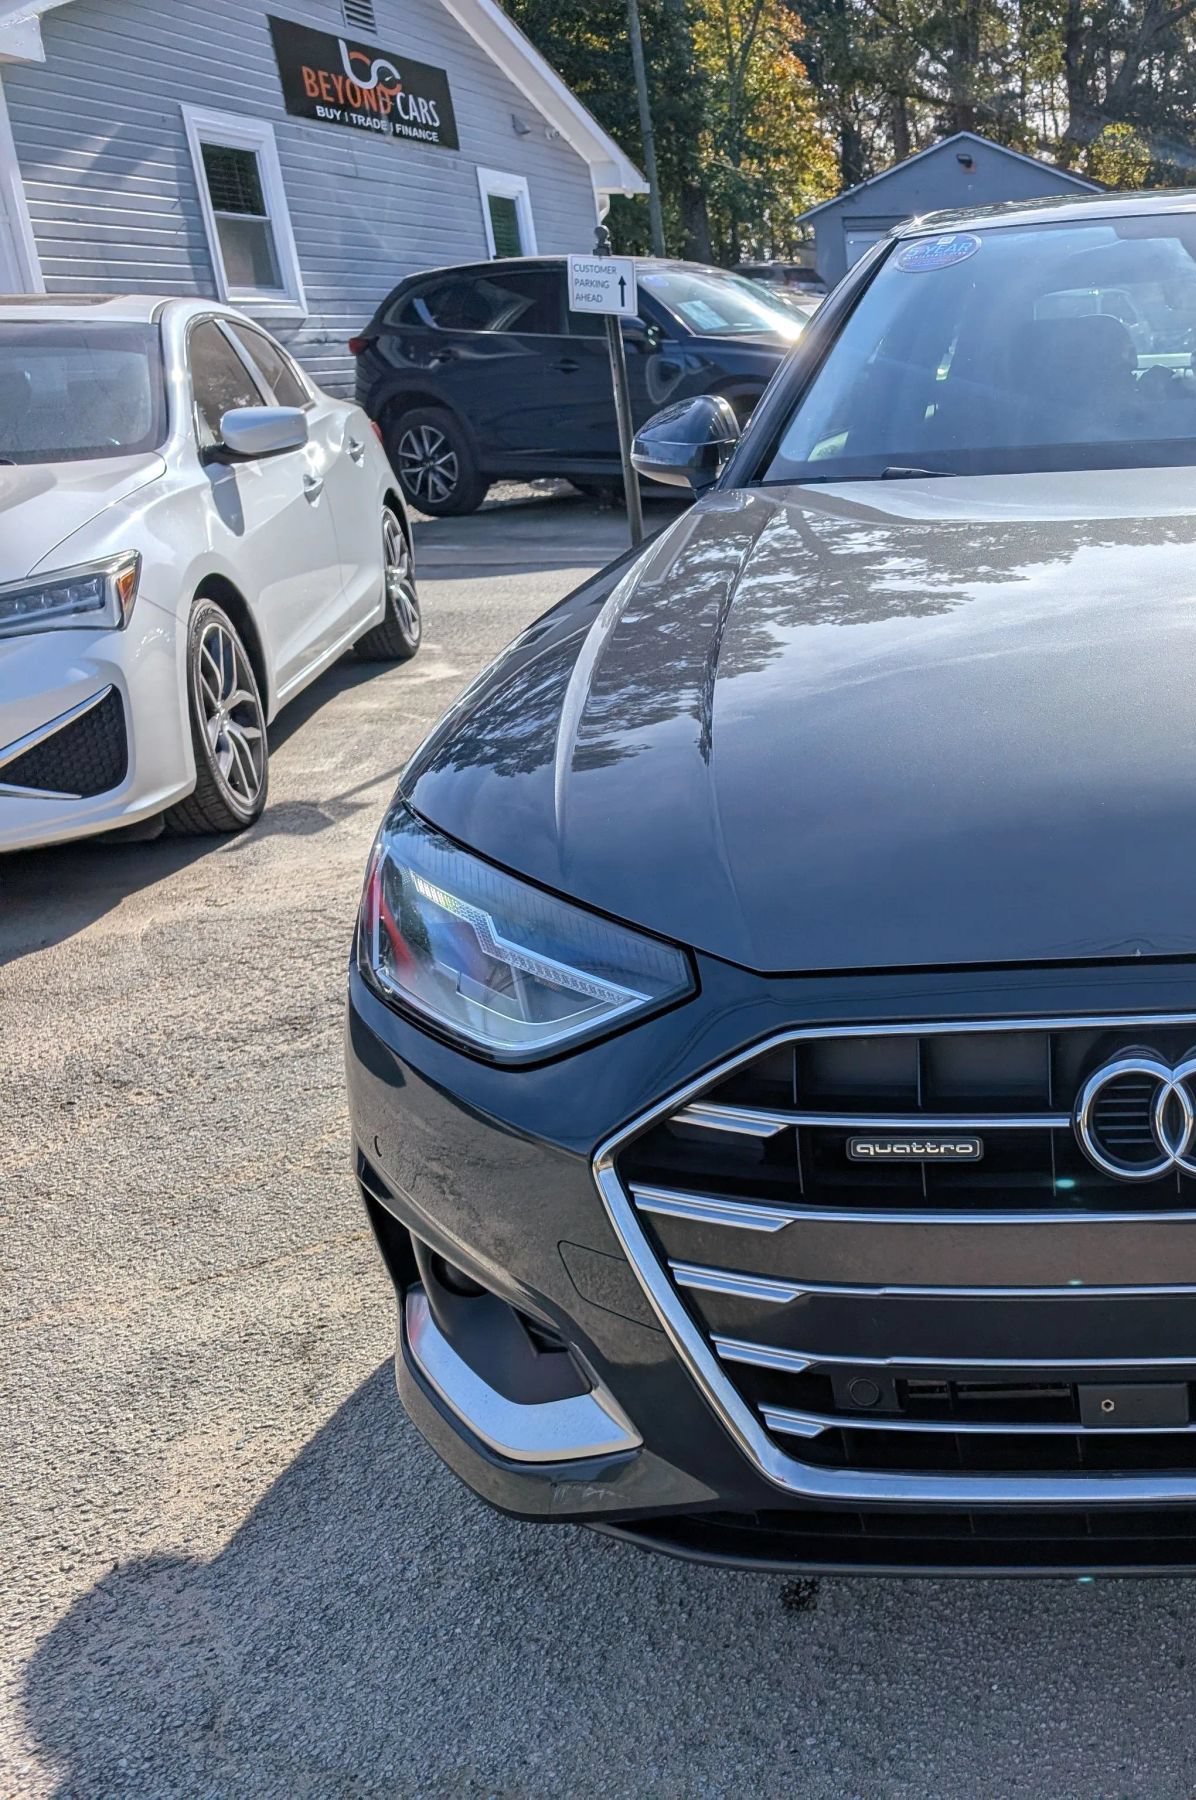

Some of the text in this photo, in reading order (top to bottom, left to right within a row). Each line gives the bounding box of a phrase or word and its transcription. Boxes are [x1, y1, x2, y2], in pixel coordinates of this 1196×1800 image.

[302, 66, 440, 127] BEYOND CARS
[316, 105, 440, 142] BUY TRADE FINANCE
[573, 263, 617, 275] CUSTOMER
[574, 278, 610, 289] PARKING
[575, 293, 604, 303] AHEAD
[856, 1142, 973, 1156] quattro
